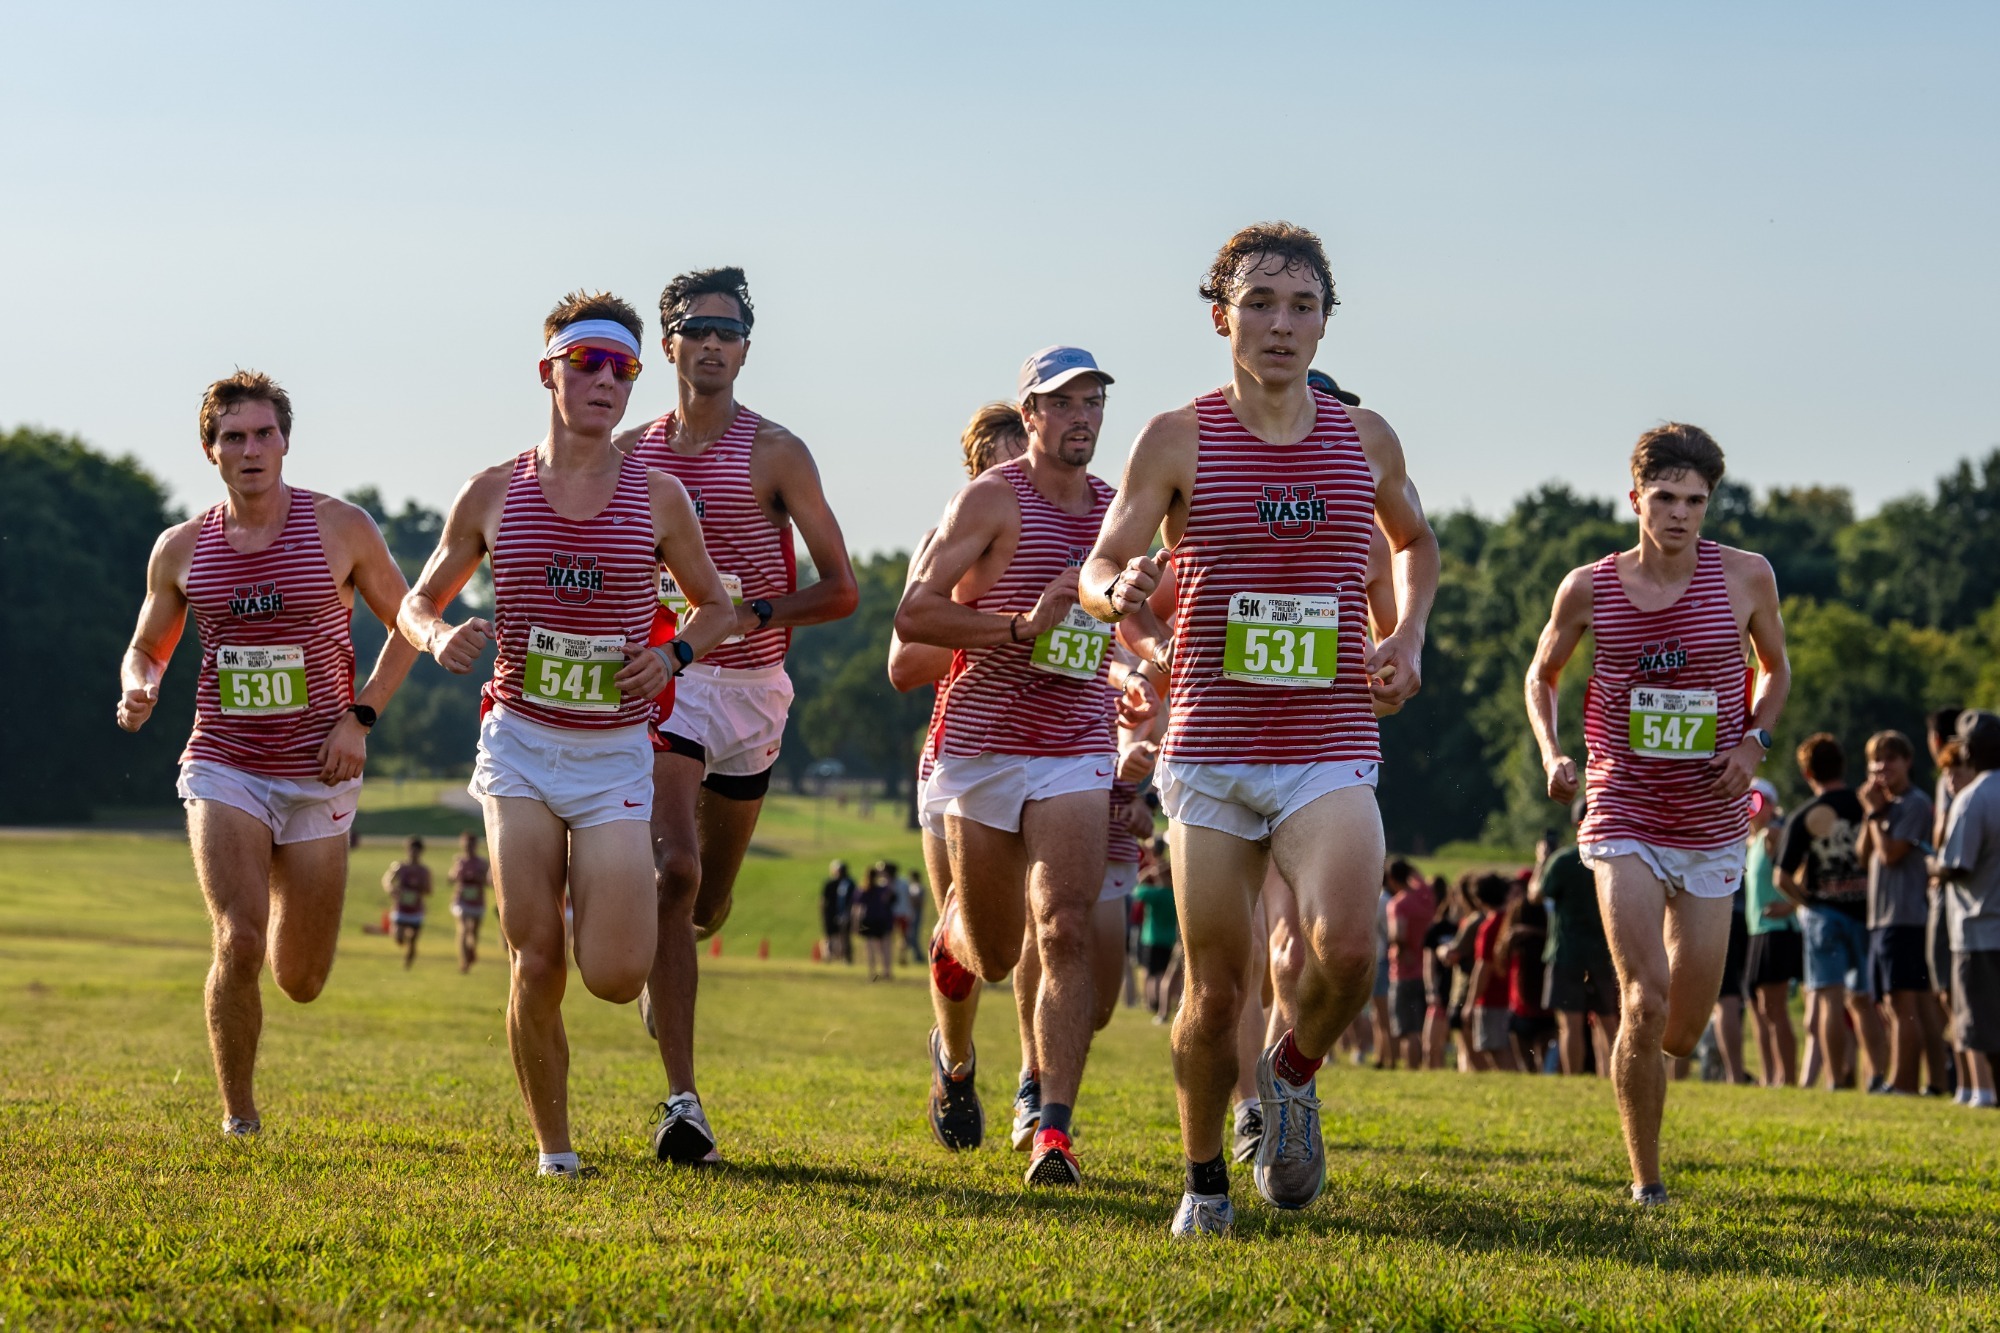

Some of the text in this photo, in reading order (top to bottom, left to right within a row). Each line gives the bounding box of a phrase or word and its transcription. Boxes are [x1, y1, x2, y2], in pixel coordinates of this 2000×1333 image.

[1255, 498, 1327, 523] WASH
[545, 566, 604, 591] WASH
[661, 579, 677, 593] 5K
[228, 592, 285, 616] WASH
[1239, 599, 1260, 617] 5K
[1268, 599, 1295, 607] FERGUSON
[1272, 612, 1288, 621] RUN
[536, 633, 555, 651] 5K
[562, 637, 586, 646] FERGUSON
[1047, 629, 1103, 671] 533
[1244, 628, 1318, 674] 531
[223, 651, 239, 665] 5K
[565, 649, 580, 658] RUN
[1637, 649, 1688, 671] WASH
[232, 671, 293, 707] 530
[539, 659, 603, 700] 541
[1638, 692, 1654, 707] 5K
[1643, 715, 1703, 750] 547
